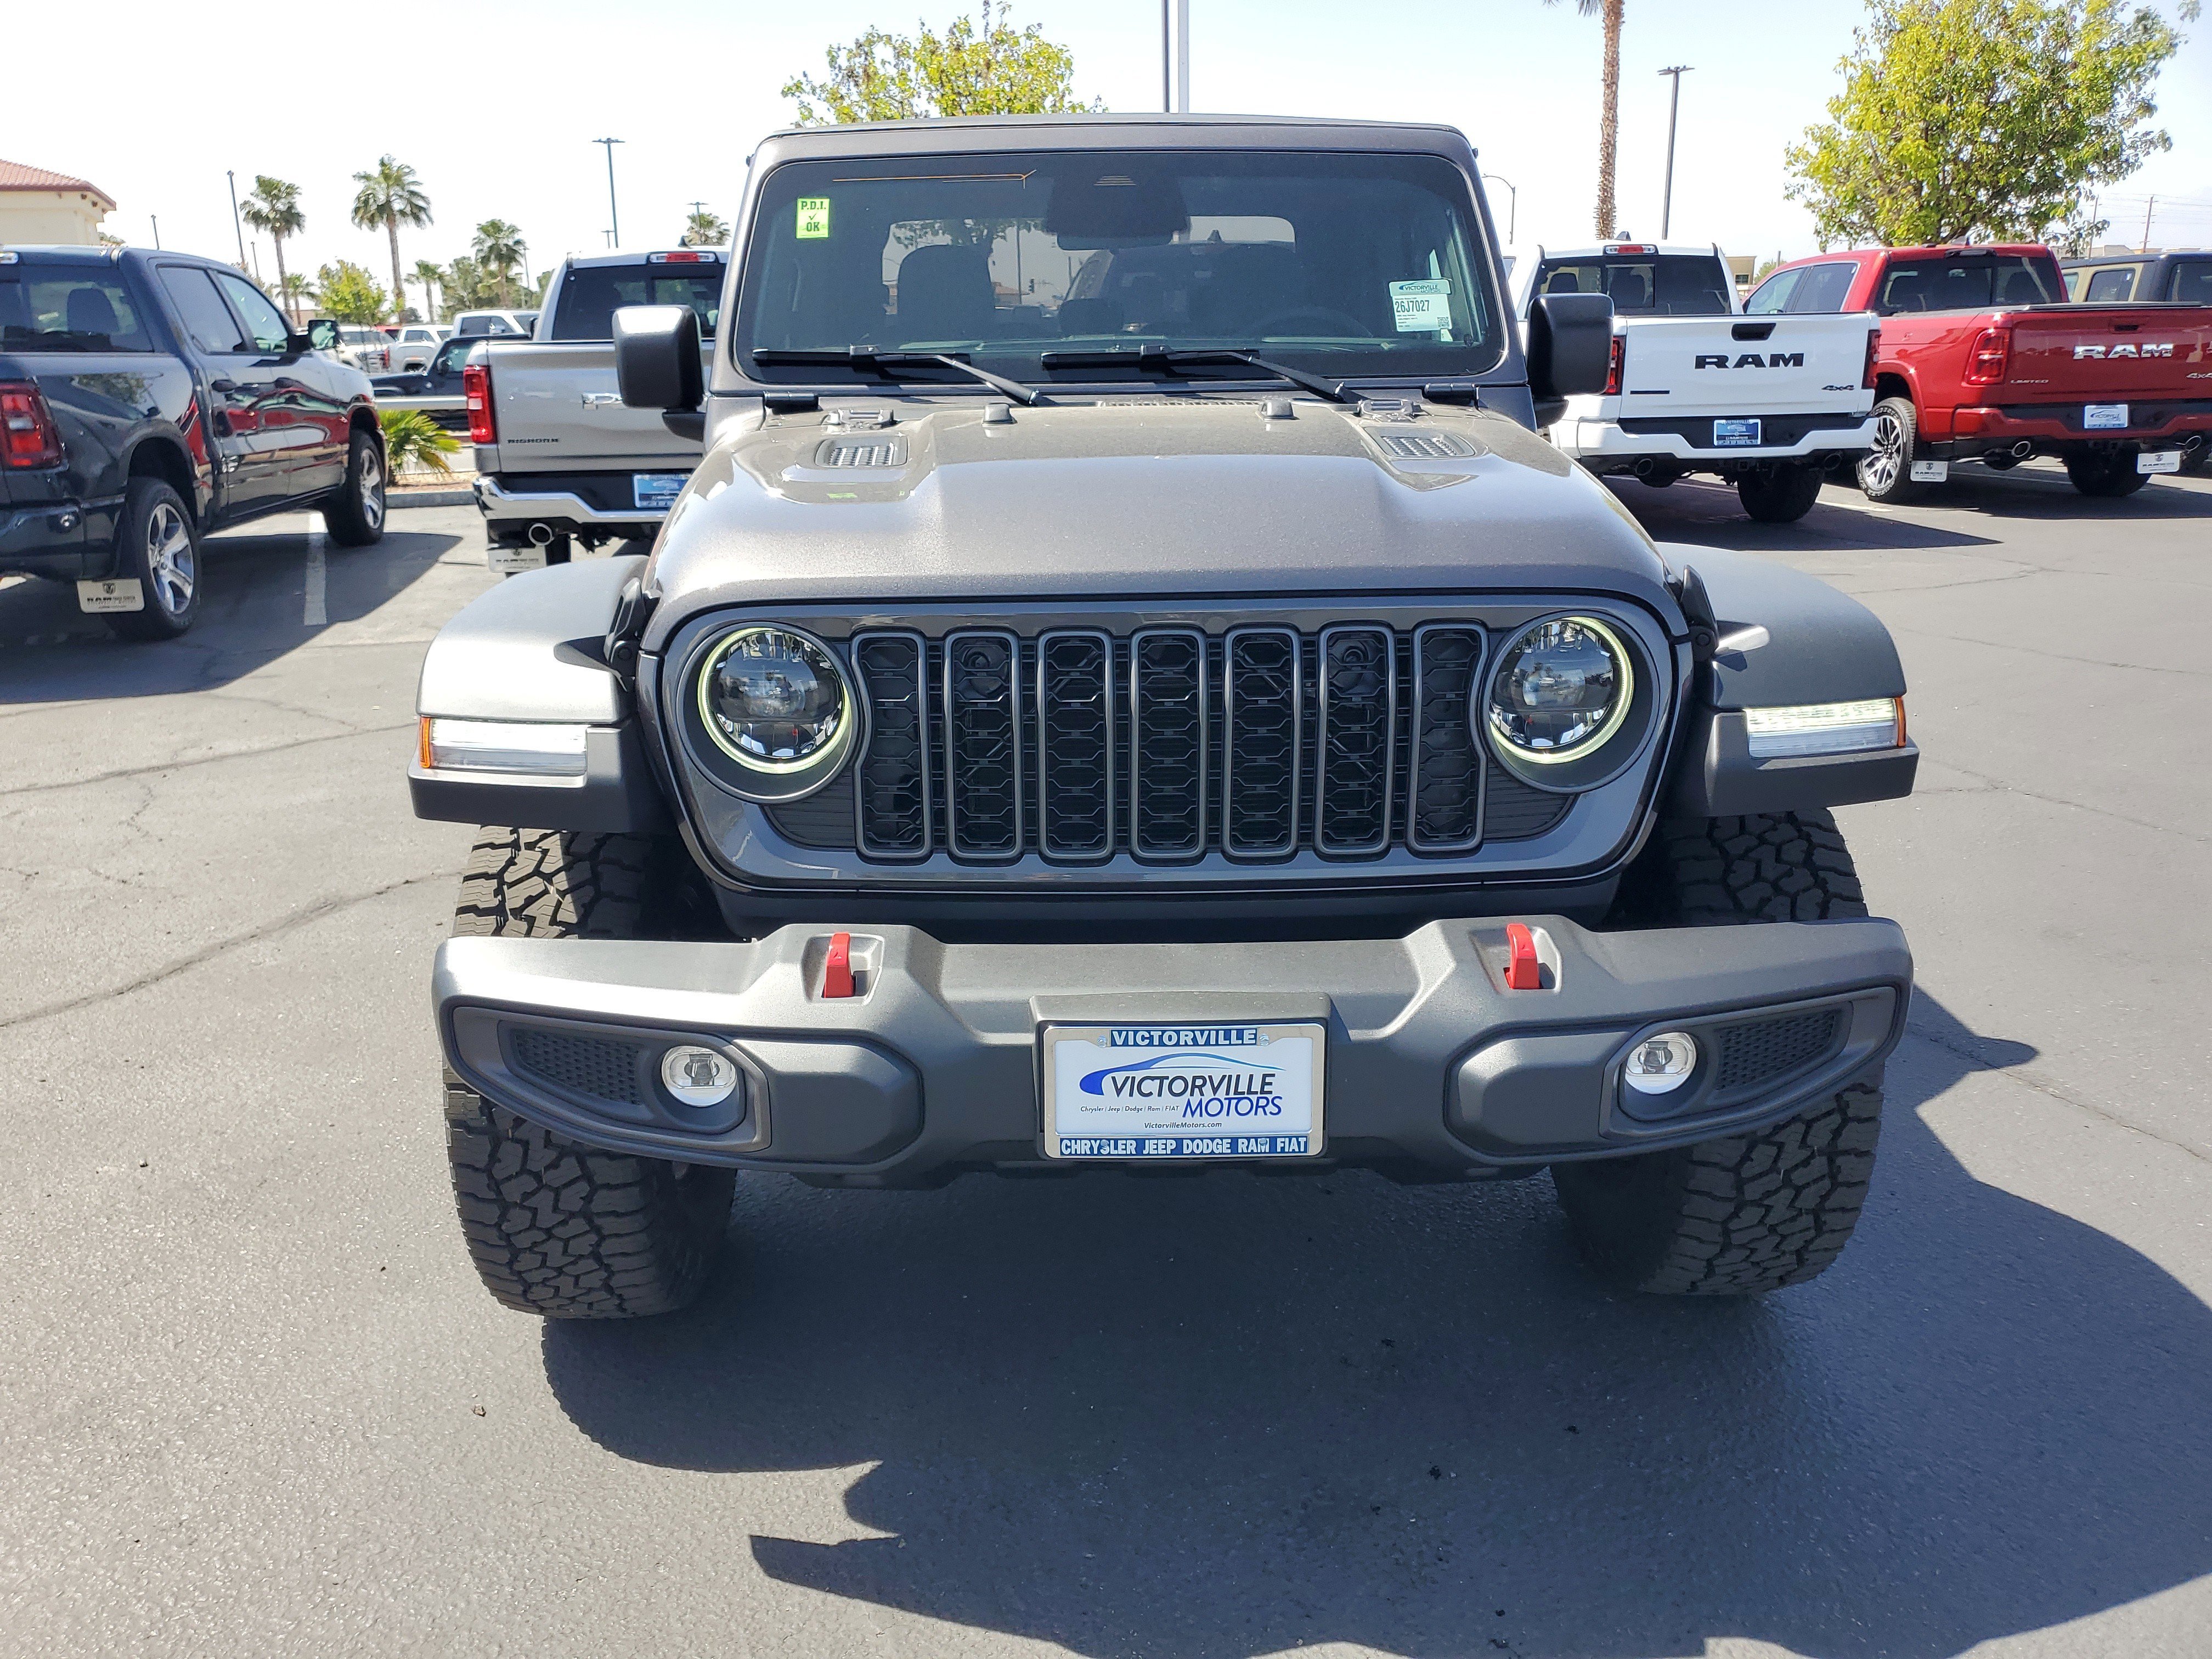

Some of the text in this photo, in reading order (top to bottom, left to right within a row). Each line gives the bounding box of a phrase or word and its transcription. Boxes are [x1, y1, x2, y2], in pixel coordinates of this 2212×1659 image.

[800, 201, 826, 210] P.D.I.
[806, 222, 820, 232] OK
[1395, 300, 1430, 313] 26J7027
[2073, 343, 2174, 360] RAM
[1694, 353, 1804, 369] RAM
[1112, 1029, 1256, 1045] VICTORVILLE
[1110, 1073, 1276, 1097] VICTORVILLE
[1182, 1096, 1283, 1118] MOTORS
[1143, 1139, 1176, 1155] JEEP
[1183, 1138, 1231, 1154] DODGE
[1238, 1138, 1269, 1153] RAM
[1277, 1137, 1307, 1153] FIAT
